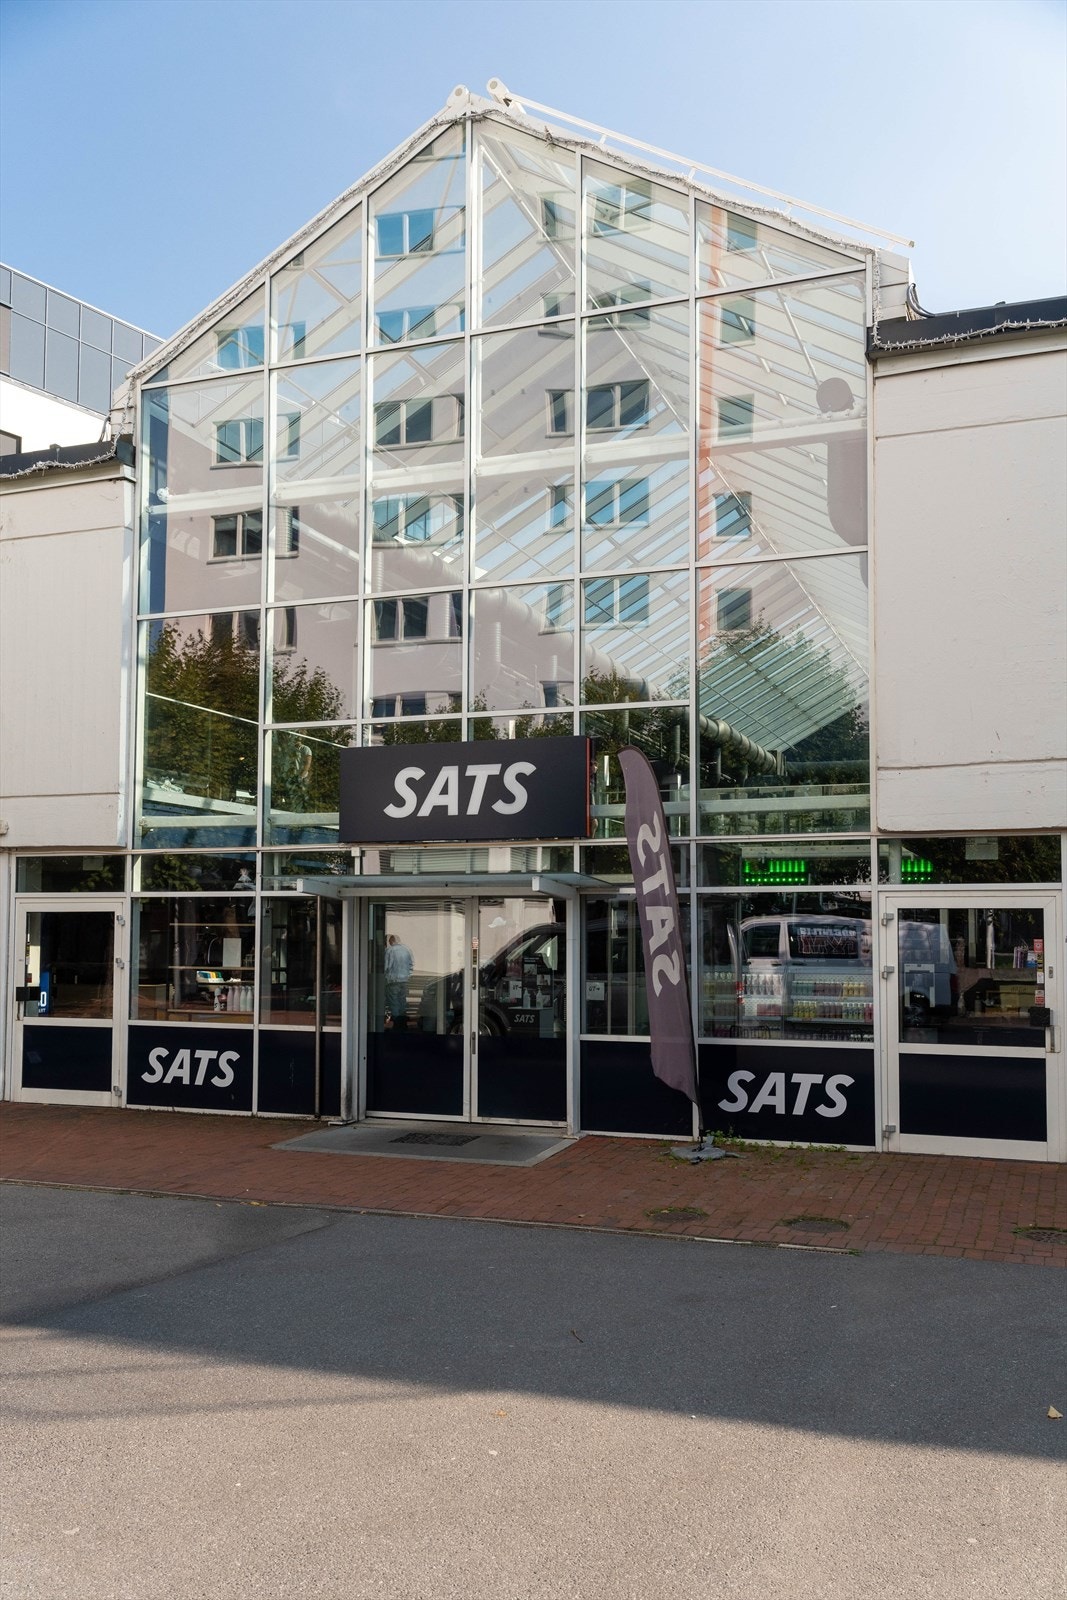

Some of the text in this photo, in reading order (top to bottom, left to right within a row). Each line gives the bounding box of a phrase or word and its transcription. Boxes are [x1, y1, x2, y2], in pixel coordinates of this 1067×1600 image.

[383, 761, 537, 819] SATS
[514, 1014, 536, 1024] SATS
[140, 1046, 241, 1088] SATS
[717, 1070, 855, 1118] SATS
